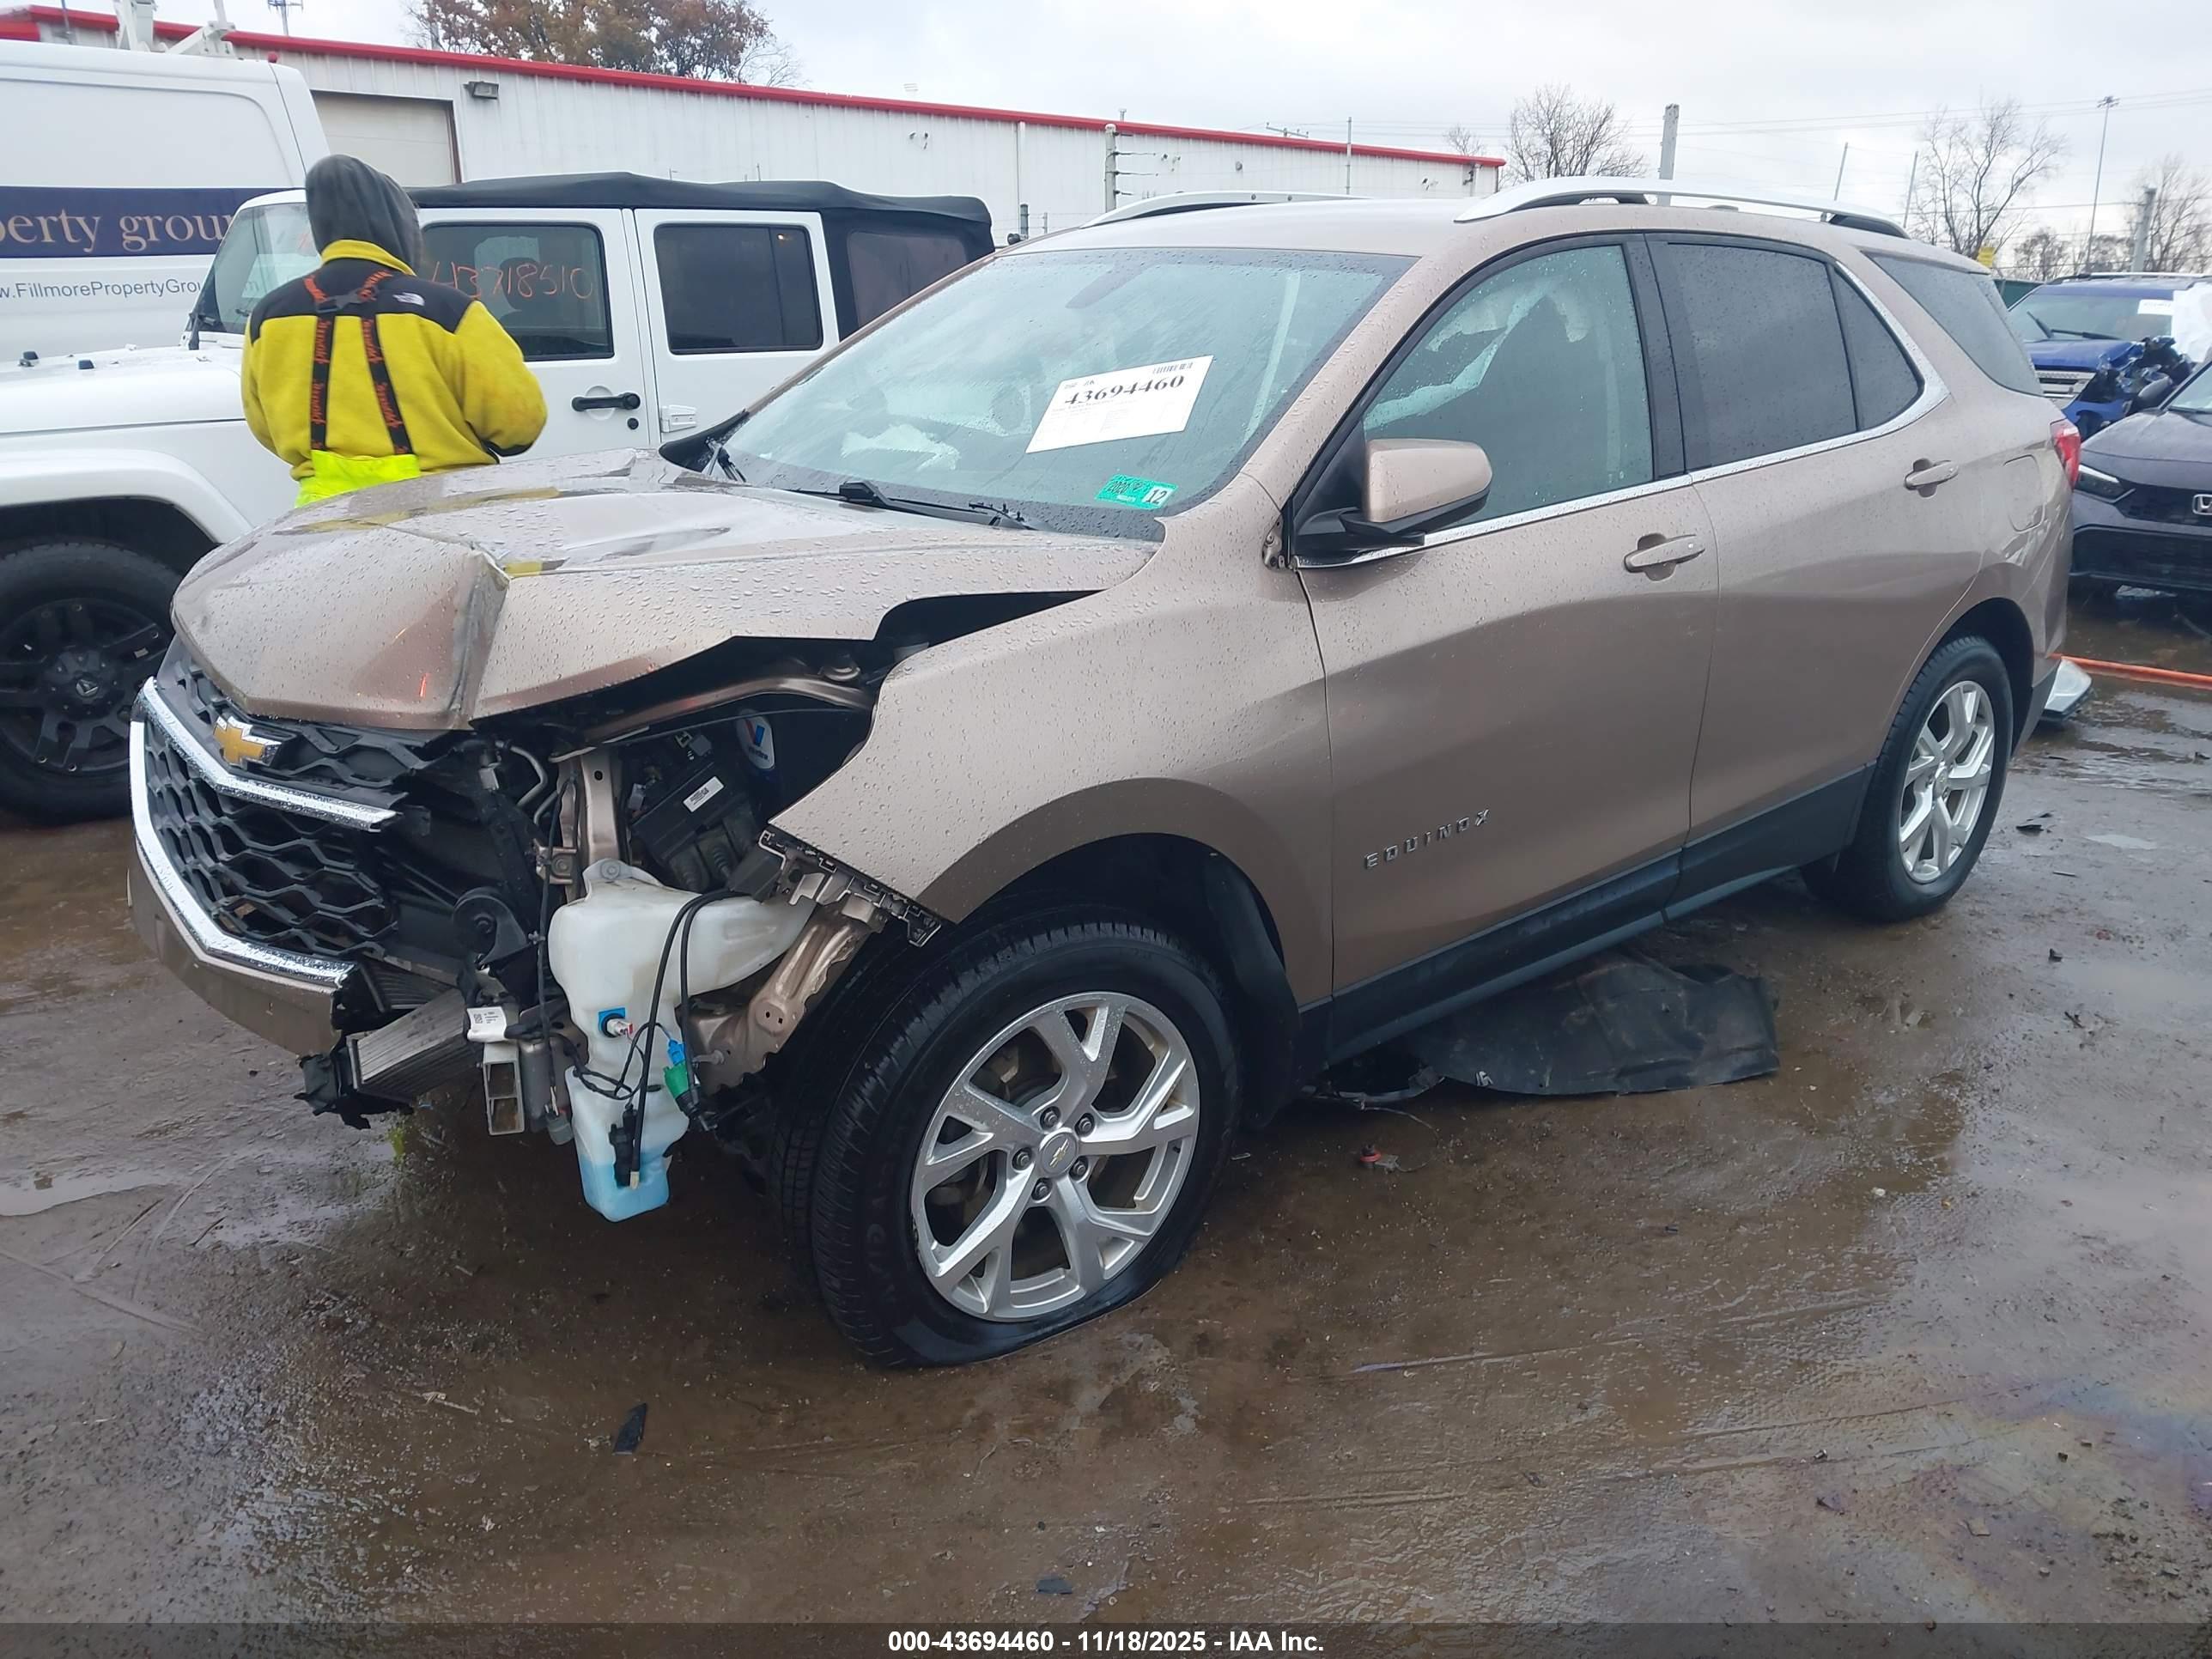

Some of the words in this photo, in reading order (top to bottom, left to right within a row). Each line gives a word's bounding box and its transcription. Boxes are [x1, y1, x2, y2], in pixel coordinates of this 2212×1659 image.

[432, 260, 592, 299] 43718510
[1065, 375, 1185, 404] 43694460
[1146, 489, 1168, 505] 12
[1365, 809, 1490, 868] EQUINOX
